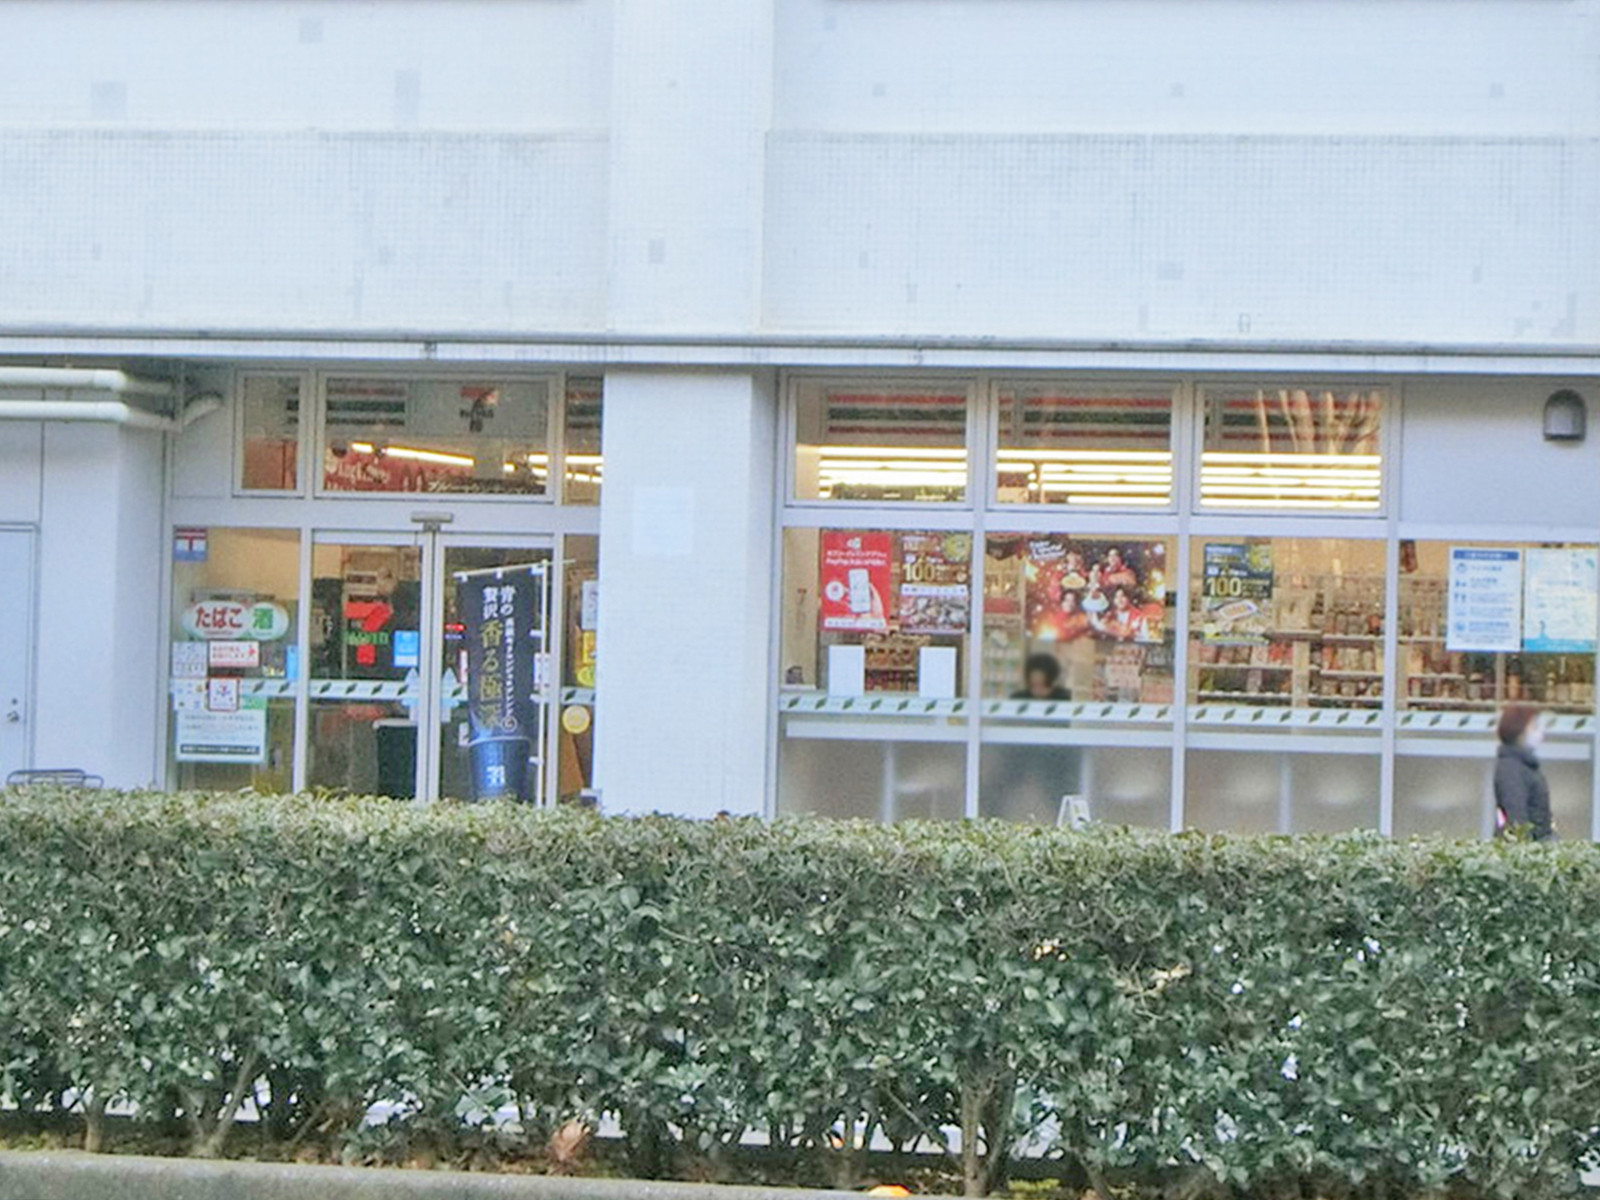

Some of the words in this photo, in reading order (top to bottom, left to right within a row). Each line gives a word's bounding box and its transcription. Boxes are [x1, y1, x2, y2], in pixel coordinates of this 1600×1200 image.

[903, 562, 936, 582] 100
[1207, 577, 1241, 597] 100
[196, 606, 243, 629] たばこ
